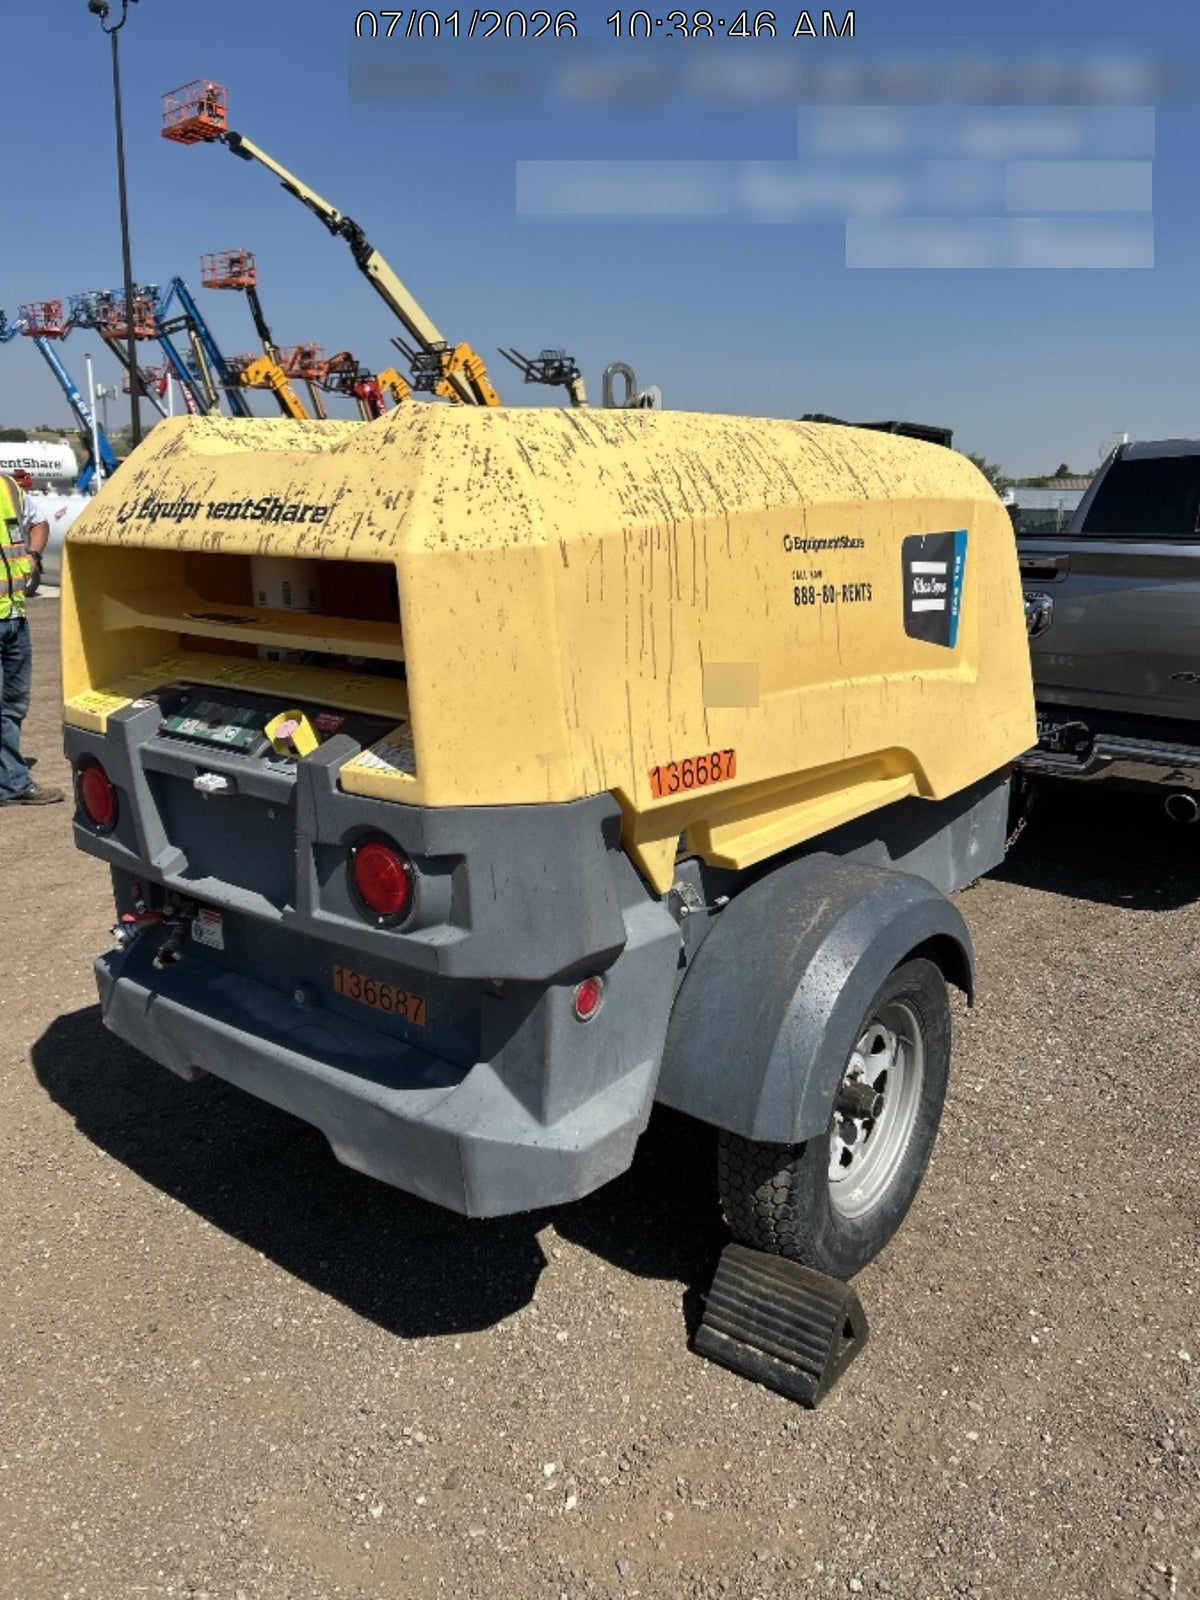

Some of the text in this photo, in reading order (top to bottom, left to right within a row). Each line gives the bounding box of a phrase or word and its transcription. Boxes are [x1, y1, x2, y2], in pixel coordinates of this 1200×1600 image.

[794, 535, 865, 553] EquipmentShare
[794, 582, 872, 607] 888-80-RENTS
[651, 748, 735, 796] 136687
[335, 967, 424, 1023] 136687
